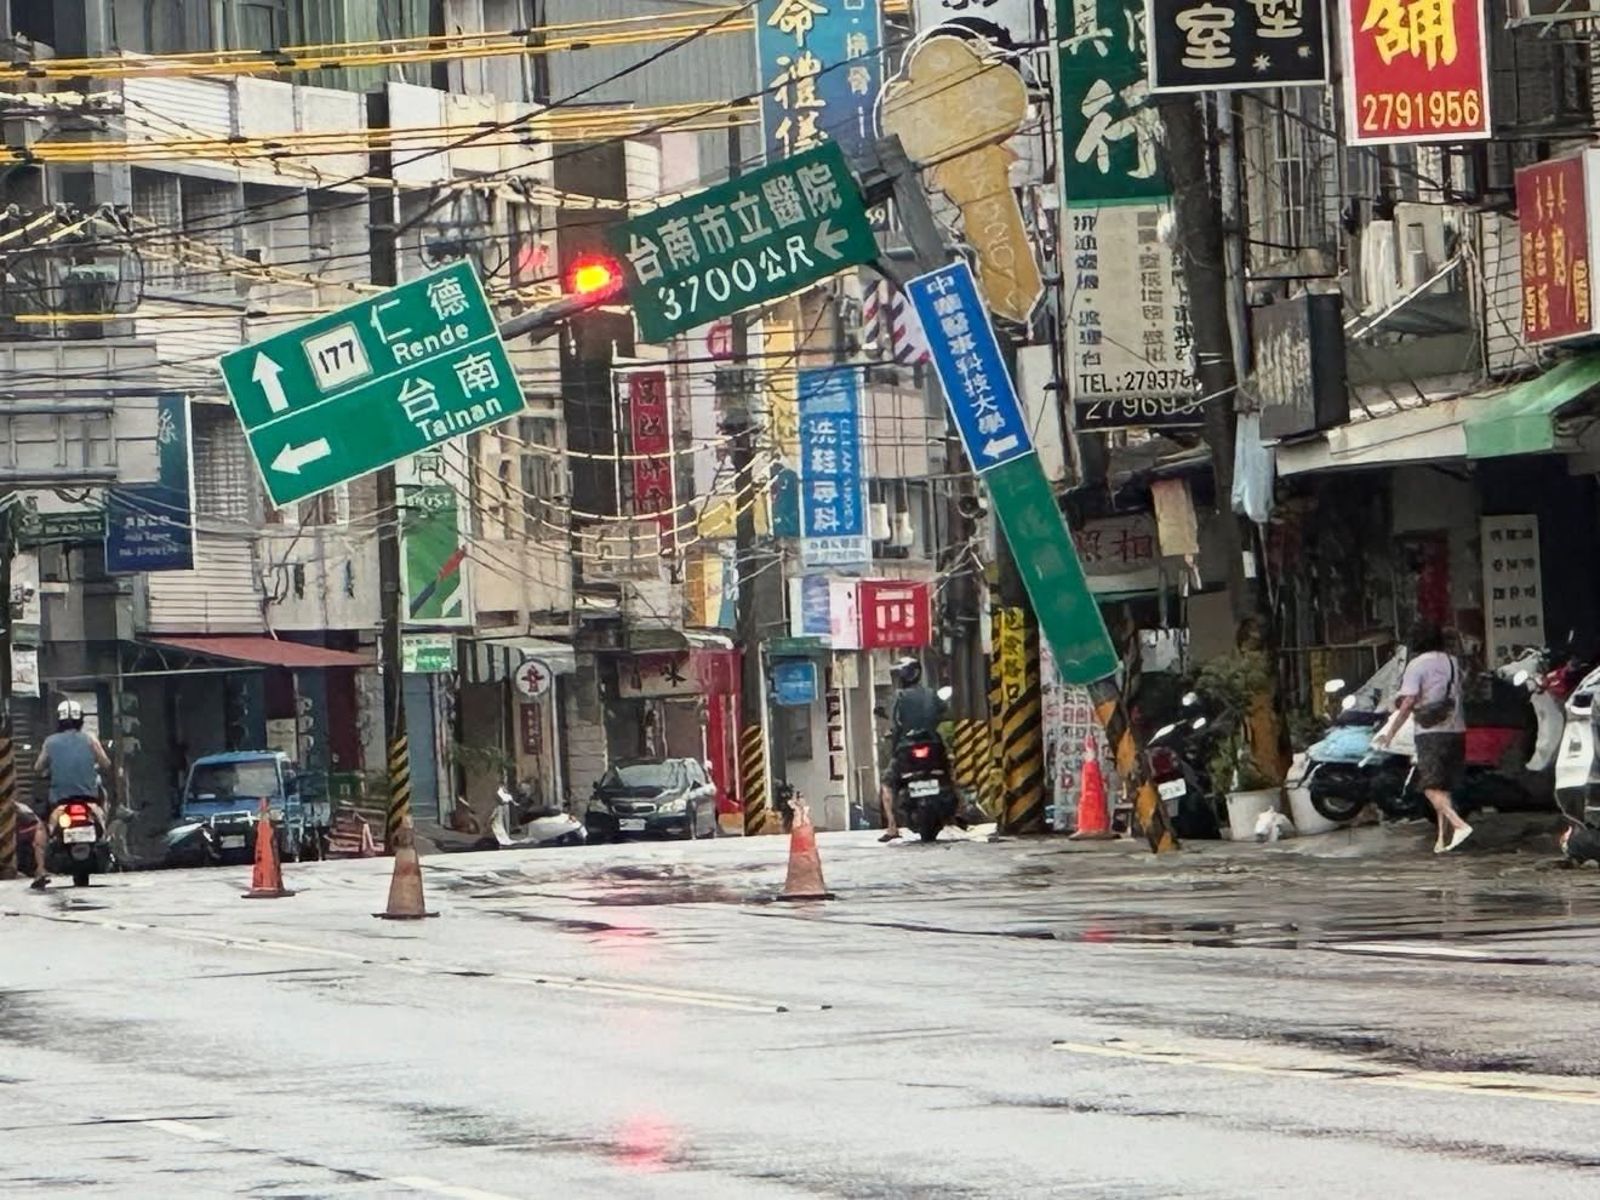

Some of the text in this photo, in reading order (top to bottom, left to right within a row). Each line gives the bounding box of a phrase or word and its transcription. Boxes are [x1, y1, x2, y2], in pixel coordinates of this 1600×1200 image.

[1176, 3, 1236, 69] 室
[1362, 90, 1480, 131] 2791956
[625, 161, 842, 285] 台南市立醫院
[370, 276, 470, 344] 仁德
[318, 340, 354, 374] 177
[392, 322, 469, 364] Rende
[398, 351, 499, 422] 台南
[415, 397, 502, 441] Tainan
